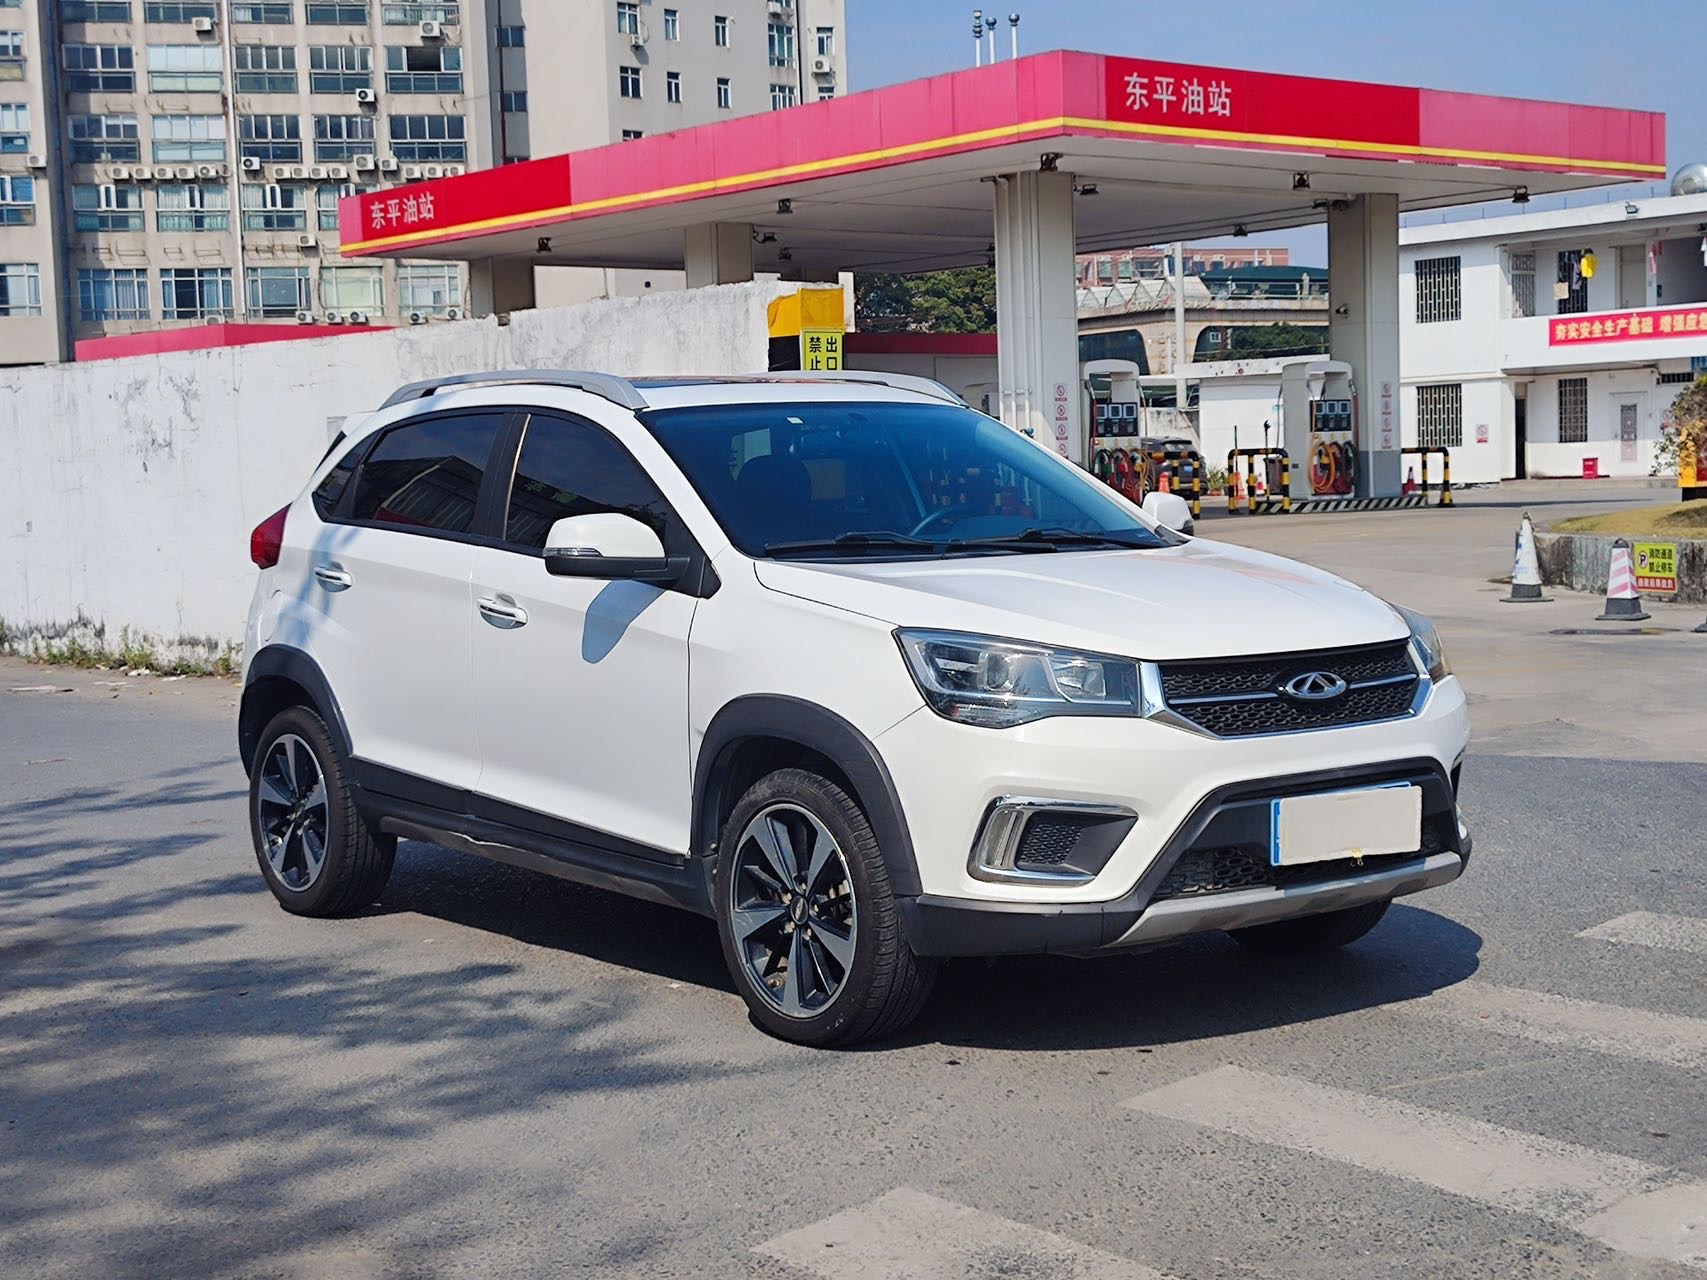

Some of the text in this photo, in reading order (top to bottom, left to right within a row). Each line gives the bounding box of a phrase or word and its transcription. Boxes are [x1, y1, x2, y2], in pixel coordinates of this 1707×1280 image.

[1124, 72, 1232, 117] 东平油站
[370, 192, 434, 229] 东平油站
[1555, 315, 1654, 340] 夯实安全生产基础
